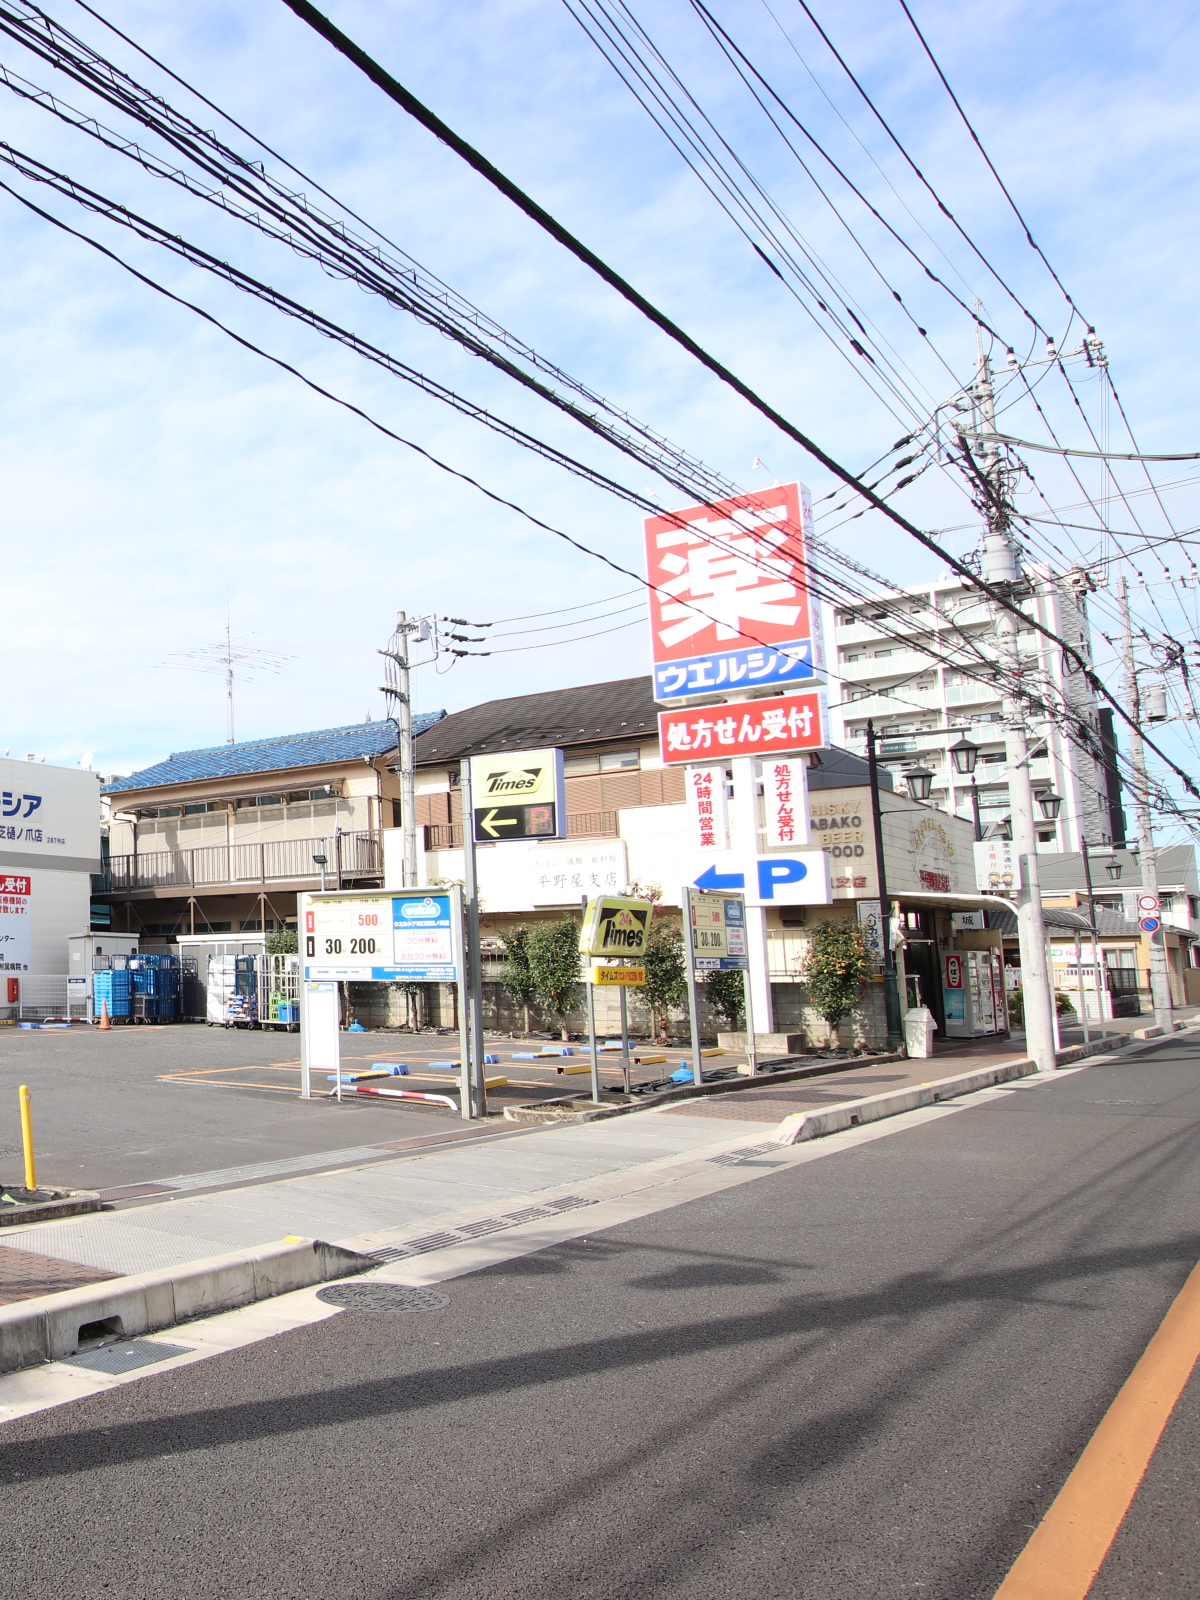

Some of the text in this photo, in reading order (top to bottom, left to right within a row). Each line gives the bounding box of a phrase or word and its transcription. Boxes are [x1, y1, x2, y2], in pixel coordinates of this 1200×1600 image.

[655, 505, 802, 648] 薬
[657, 645, 808, 693] ウエルシア
[667, 705, 813, 752] 処方せん受付
[487, 772, 536, 793] Times
[693, 772, 716, 846] 24時間営業
[774, 764, 795, 842] 処方せん受付
[810, 801, 861, 816] HISKY
[531, 807, 549, 834] P
[810, 816, 862, 831] ABAKO
[821, 830, 863, 844] BEER
[536, 871, 618, 889] 平野屋支店
[757, 859, 808, 899] P
[831, 876, 867, 888] 支店
[602, 919, 644, 948] Times
